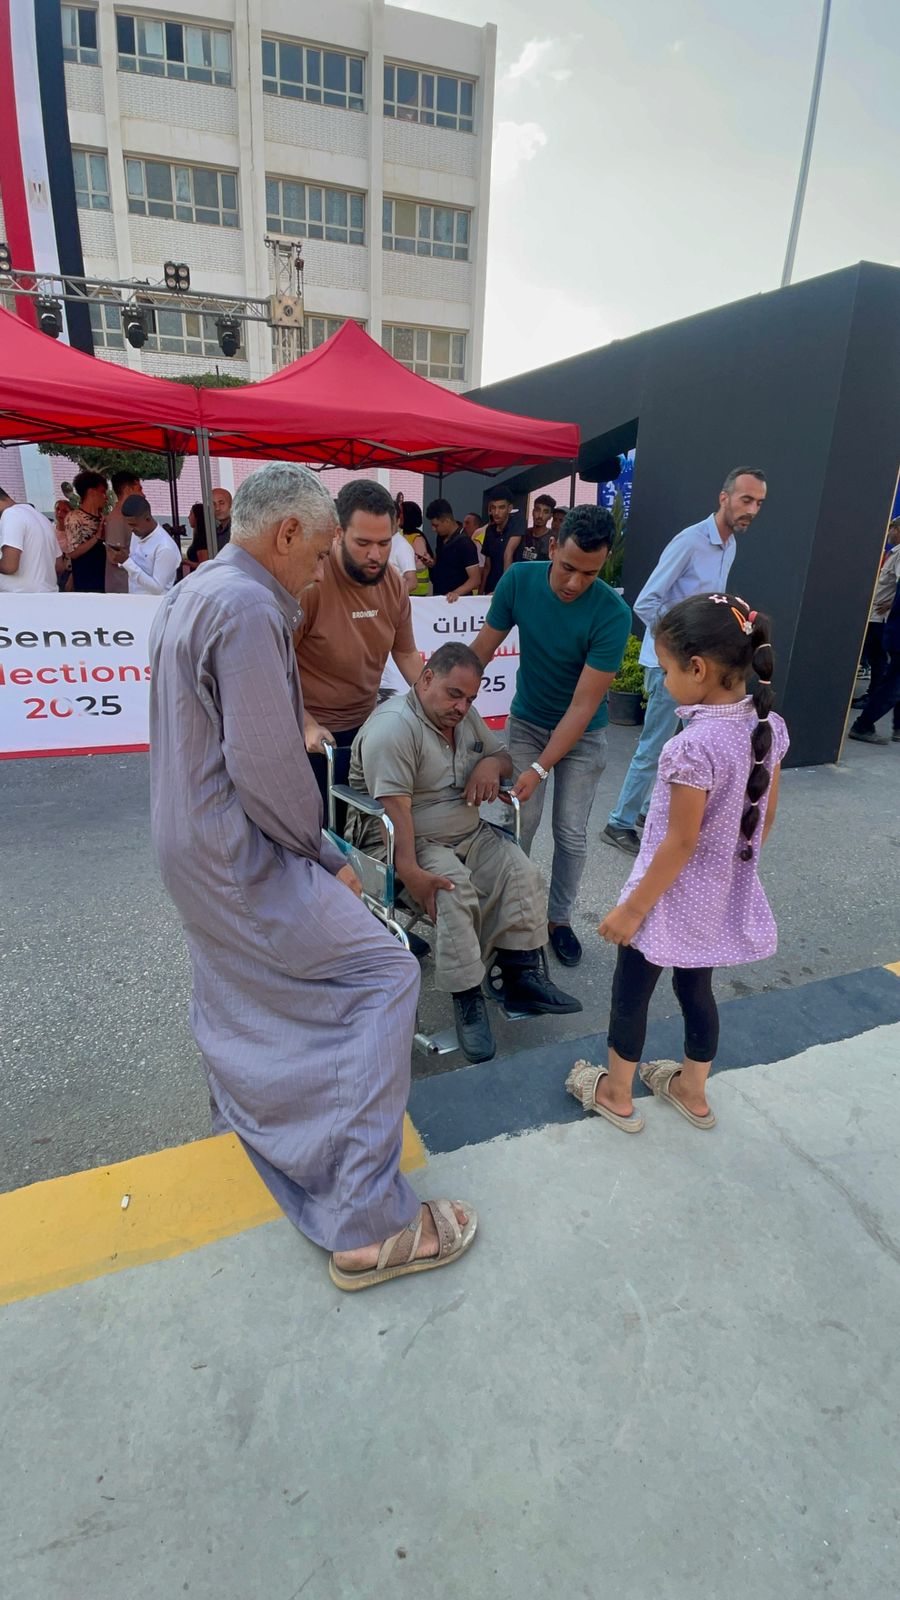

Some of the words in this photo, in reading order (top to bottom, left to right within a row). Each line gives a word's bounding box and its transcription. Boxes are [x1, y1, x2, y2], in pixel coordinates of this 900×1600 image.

[432, 616, 486, 637] خابات
[0, 627, 135, 649] Senate
[481, 675, 506, 692] 25
[23, 695, 122, 719] 2025
